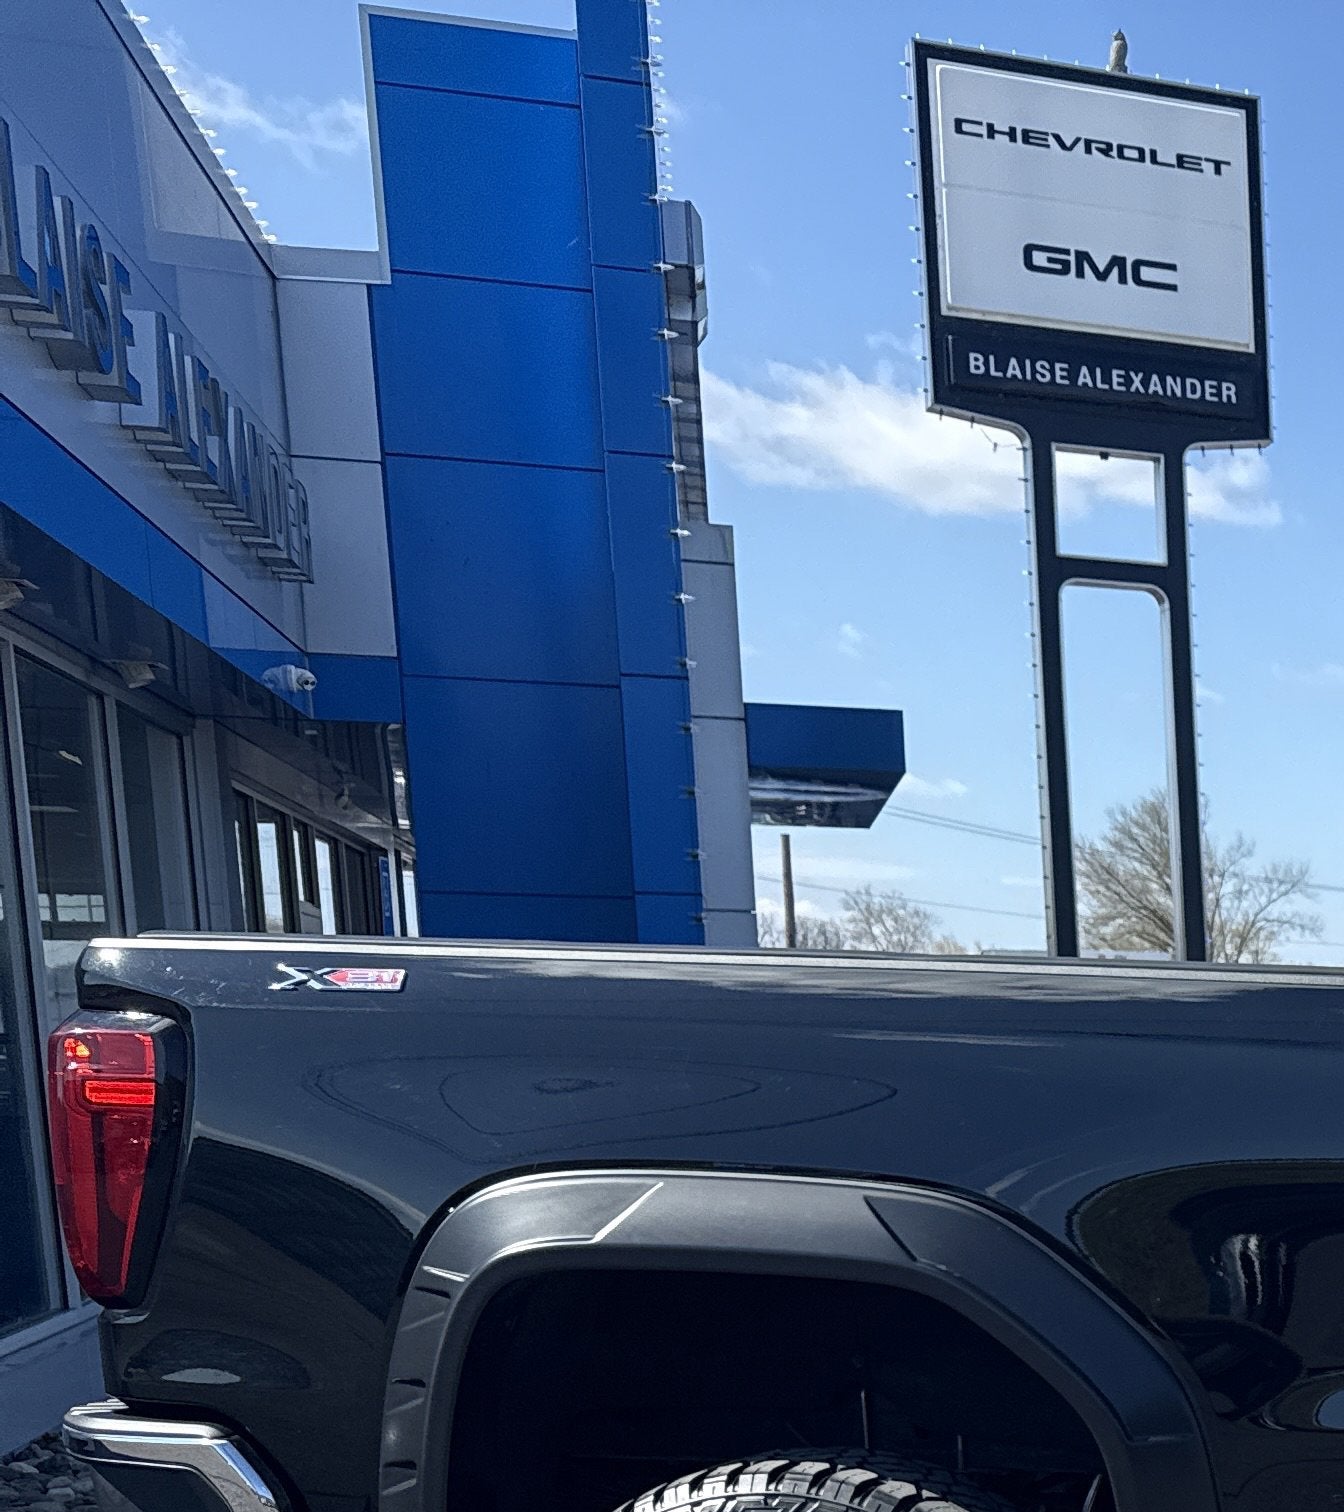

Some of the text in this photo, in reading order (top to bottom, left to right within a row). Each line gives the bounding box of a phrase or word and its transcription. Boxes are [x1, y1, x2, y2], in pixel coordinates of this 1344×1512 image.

[953, 117, 1231, 177] CHEVROLET
[1022, 242, 1179, 292] GMC
[967, 351, 1238, 405] BLAISE ALEXANDER
